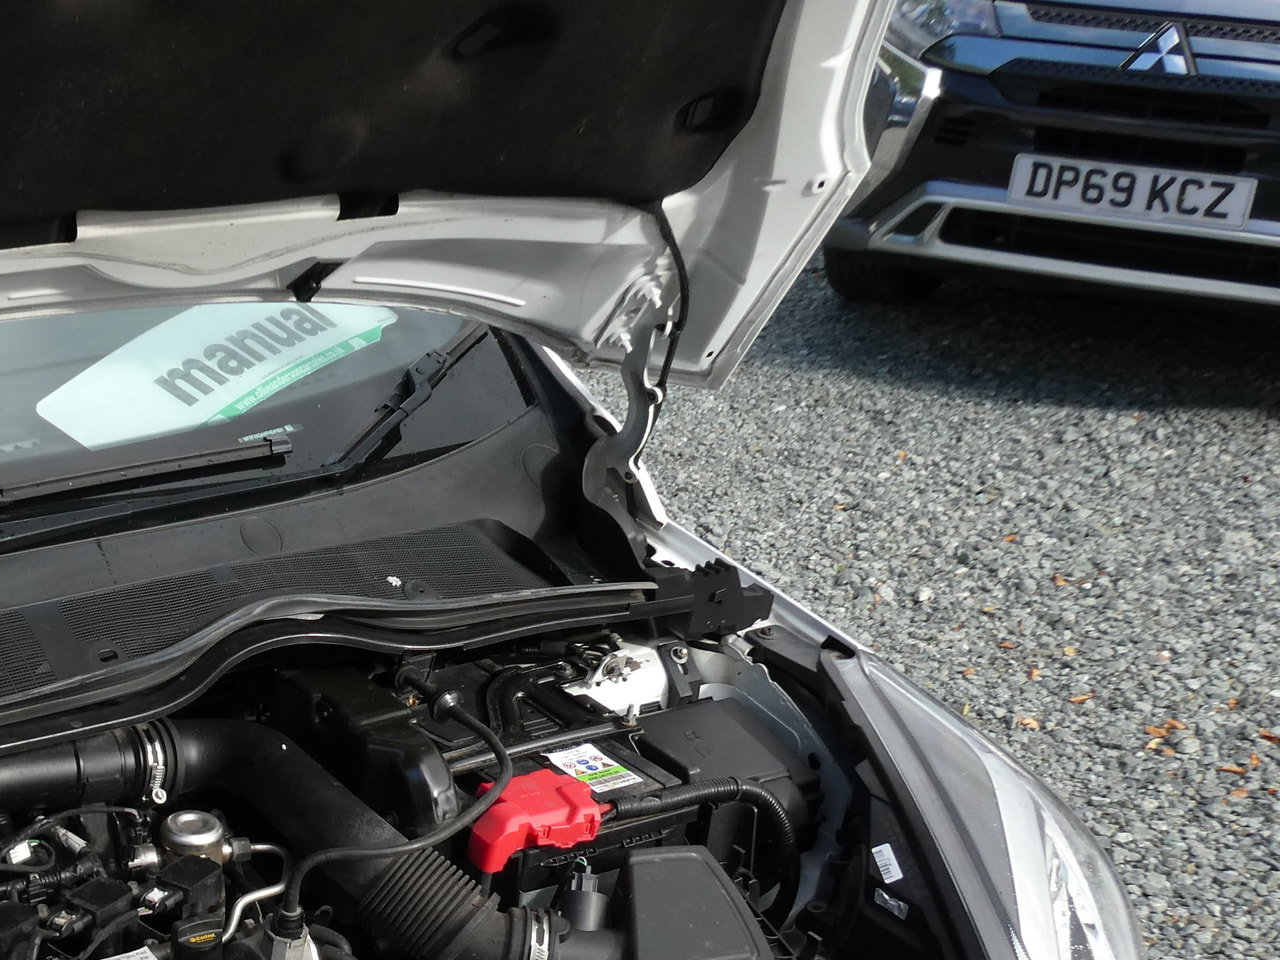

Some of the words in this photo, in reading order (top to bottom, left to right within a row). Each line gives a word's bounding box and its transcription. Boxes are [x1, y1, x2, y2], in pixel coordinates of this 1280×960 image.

[1024, 161, 1138, 209] DP69
[1146, 174, 1237, 219] KCZ
[154, 302, 337, 407] manual
